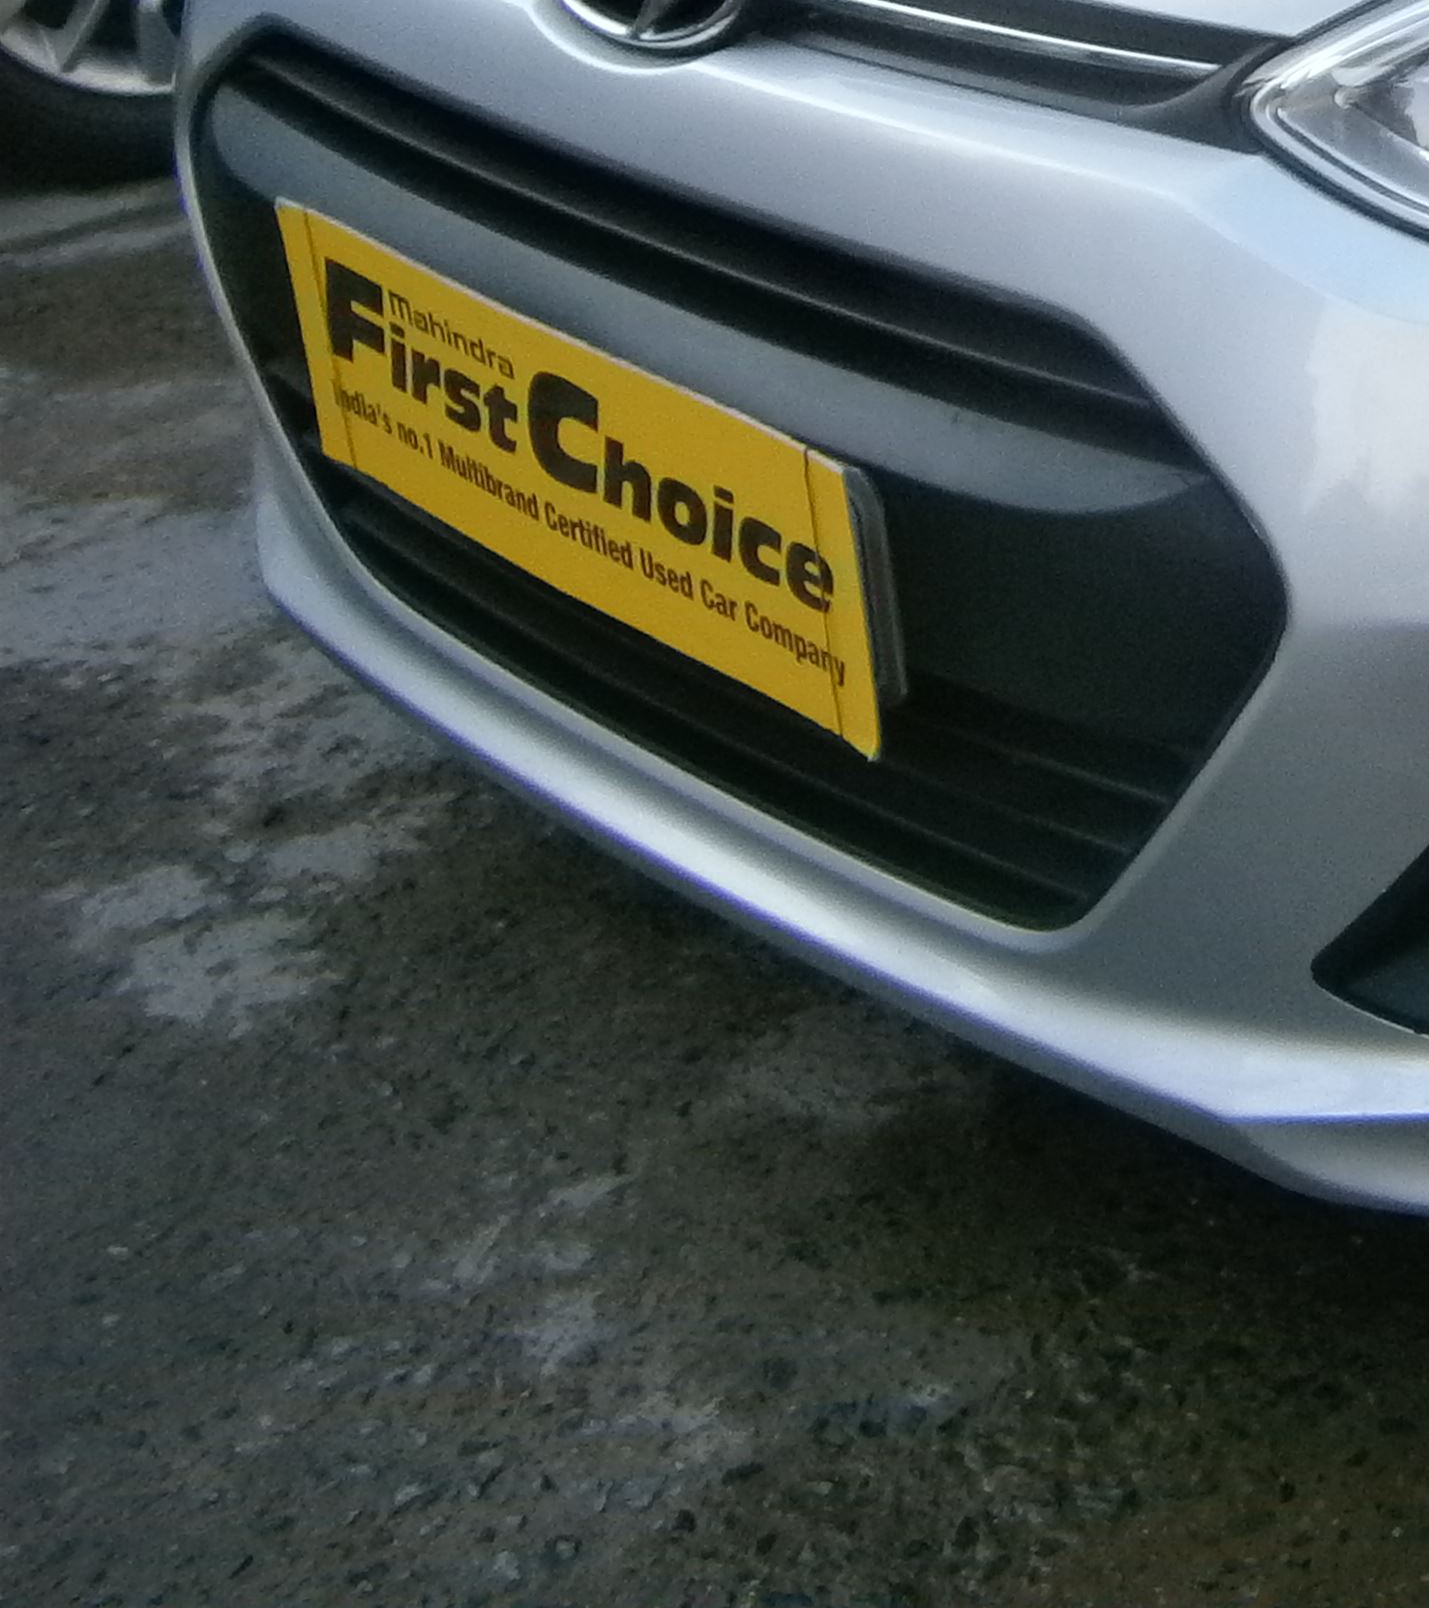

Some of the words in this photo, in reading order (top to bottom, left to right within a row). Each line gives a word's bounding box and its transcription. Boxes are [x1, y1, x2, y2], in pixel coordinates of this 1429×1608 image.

[324, 256, 517, 454] First
[528, 371, 835, 614] Choice
[333, 379, 393, 435] India's
[397, 418, 434, 460] no.1
[439, 441, 539, 523] Multibrand
[545, 502, 633, 571] Certified
[640, 552, 694, 600] Used
[701, 581, 737, 624] Car
[744, 603, 845, 688] Company
